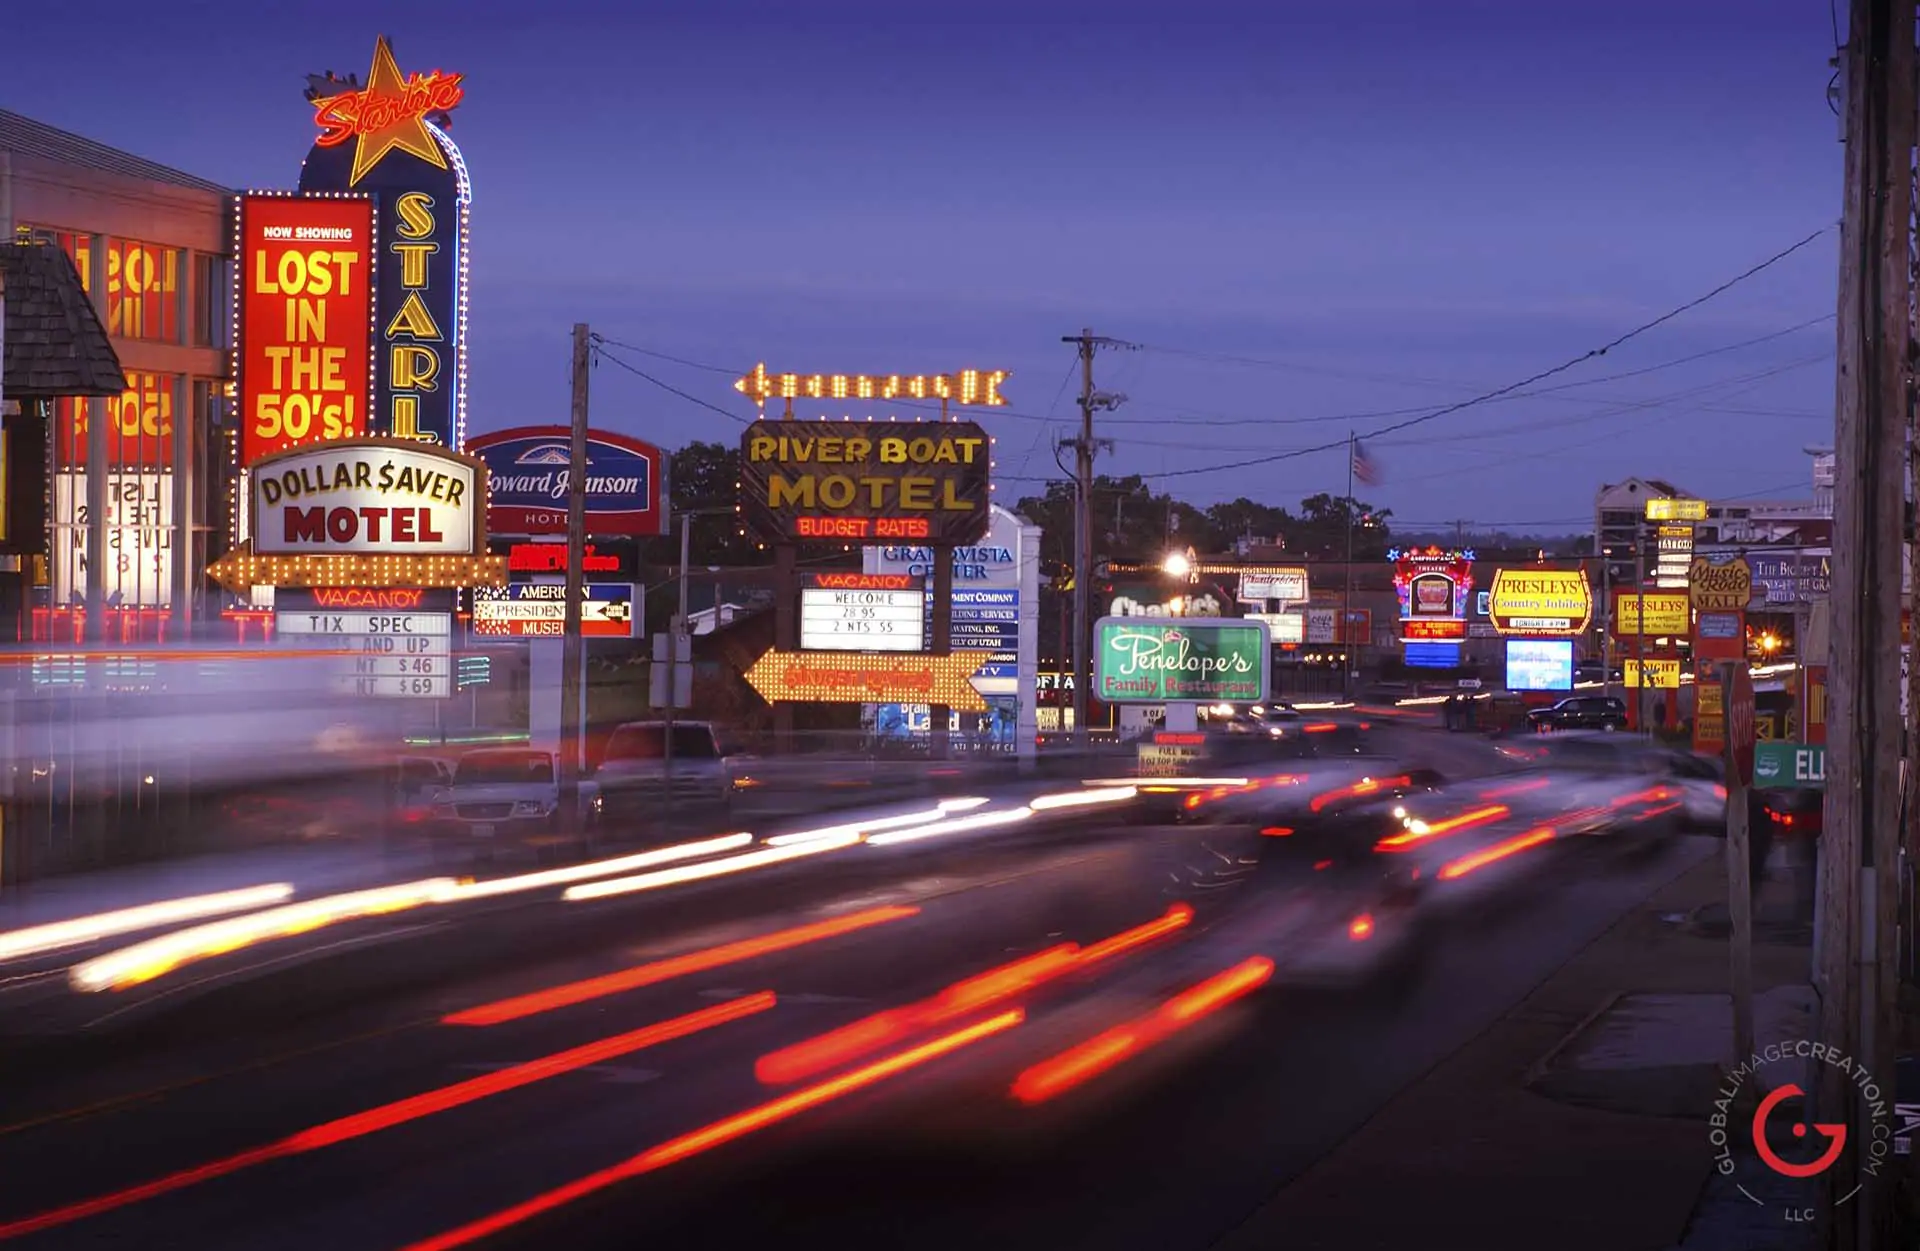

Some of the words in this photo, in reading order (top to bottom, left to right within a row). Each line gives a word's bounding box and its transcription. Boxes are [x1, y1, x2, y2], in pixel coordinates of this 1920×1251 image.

[313, 69, 464, 147] Starlite
[264, 226, 292, 239] NOW
[295, 226, 352, 240] SHOWING
[256, 250, 358, 296] LOST
[286, 298, 326, 343] IN
[264, 346, 346, 392] THE
[255, 393, 354, 440] 50's!
[751, 436, 872, 463] RIVER
[879, 437, 982, 464] BOAT
[261, 460, 371, 506] DOLLAR
[378, 459, 465, 507] $AVER
[490, 472, 549, 493] oward
[768, 474, 976, 511] MOTEL
[283, 505, 443, 544] MOTEL
[797, 518, 868, 537] BUDGET
[876, 518, 929, 537] RATES
[908, 564, 988, 579] CETER
[1692, 564, 1745, 584] Music
[1502, 579, 1581, 595] PRESLEYS'
[1703, 574, 1749, 592] Road
[835, 593, 894, 605] WELCOME
[1495, 599, 1540, 612] Country
[1544, 599, 1586, 610] Jubilee
[1623, 600, 1685, 612] PRSLEYS'
[1696, 595, 1743, 608] MALL
[980, 610, 1014, 619] SERVICES
[309, 615, 344, 632] TIX
[368, 616, 412, 633] SPEC
[847, 621, 871, 633] NTS
[362, 637, 394, 653] AND
[406, 638, 430, 653] UP
[979, 638, 1001, 647] UTAH
[1110, 633, 1252, 681] Penelope's
[1105, 677, 1157, 694] Family
[1165, 676, 1255, 693] Restaurant
